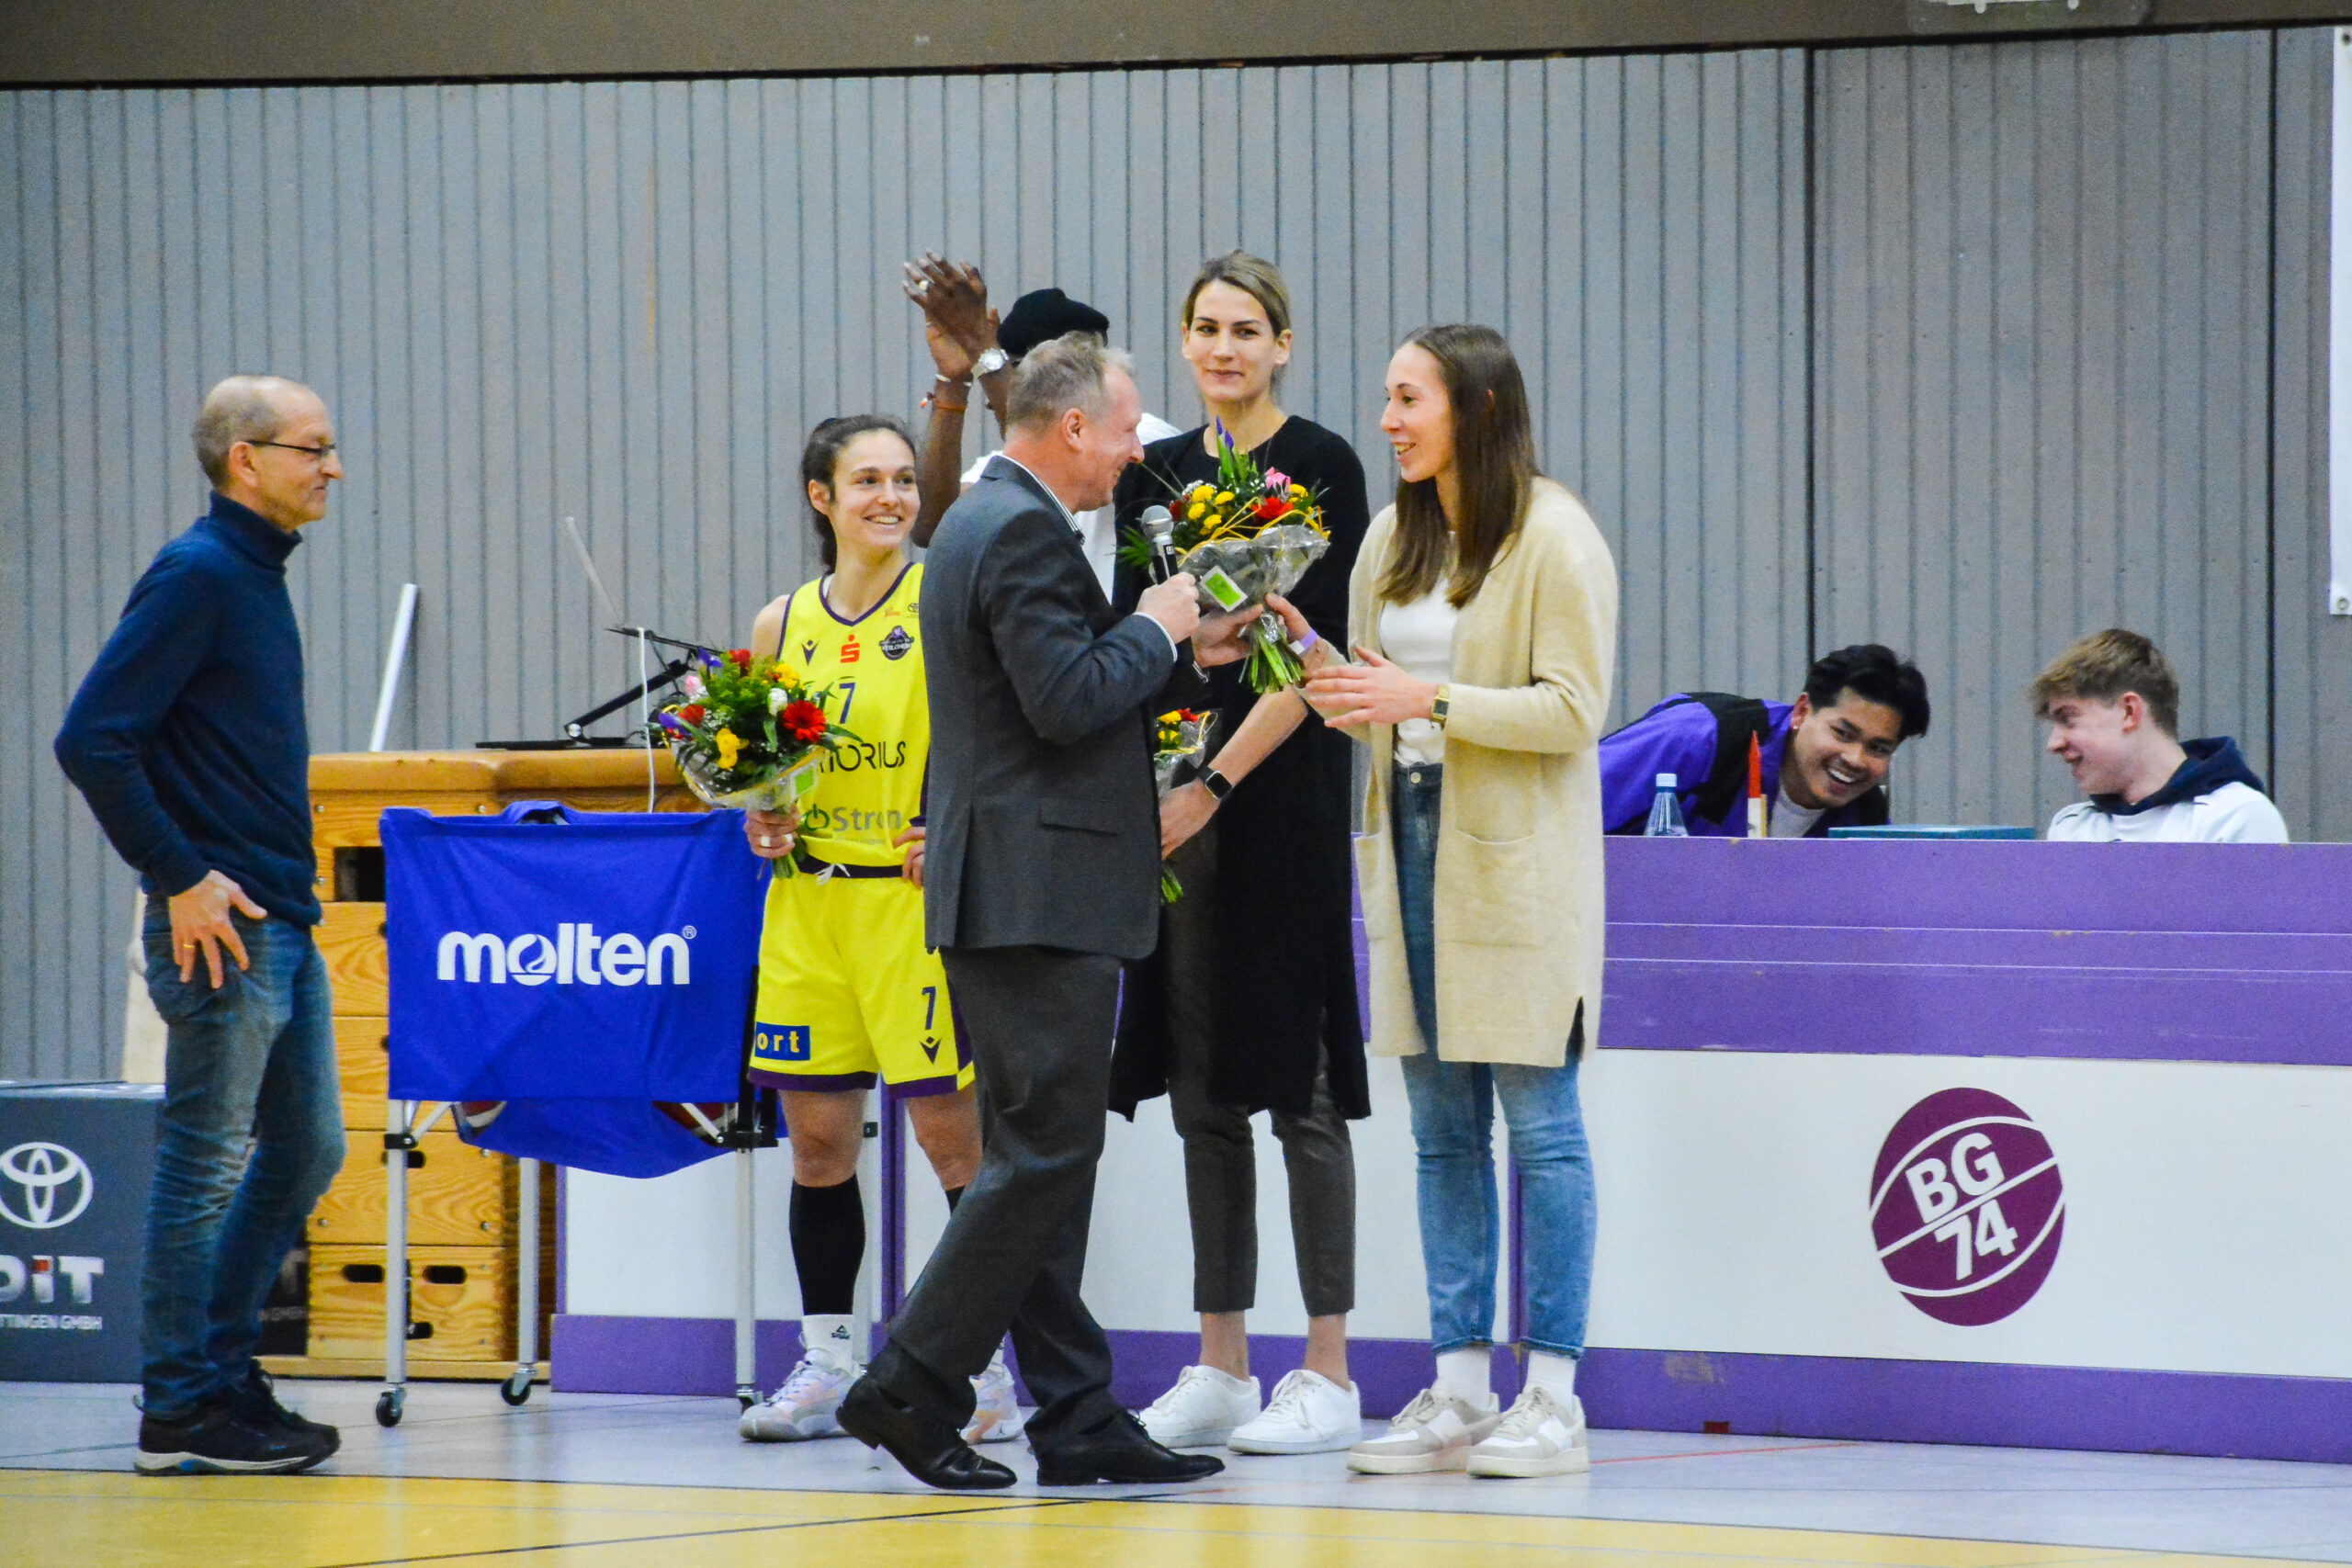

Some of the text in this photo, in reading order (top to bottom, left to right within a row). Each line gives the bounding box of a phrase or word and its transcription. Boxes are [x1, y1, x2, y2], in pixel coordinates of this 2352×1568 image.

[839, 682, 856, 724] 7
[437, 922, 690, 987] molten
[922, 986, 936, 1031] 7
[1905, 1133, 2006, 1224] BG
[1934, 1199, 2018, 1280] 74
